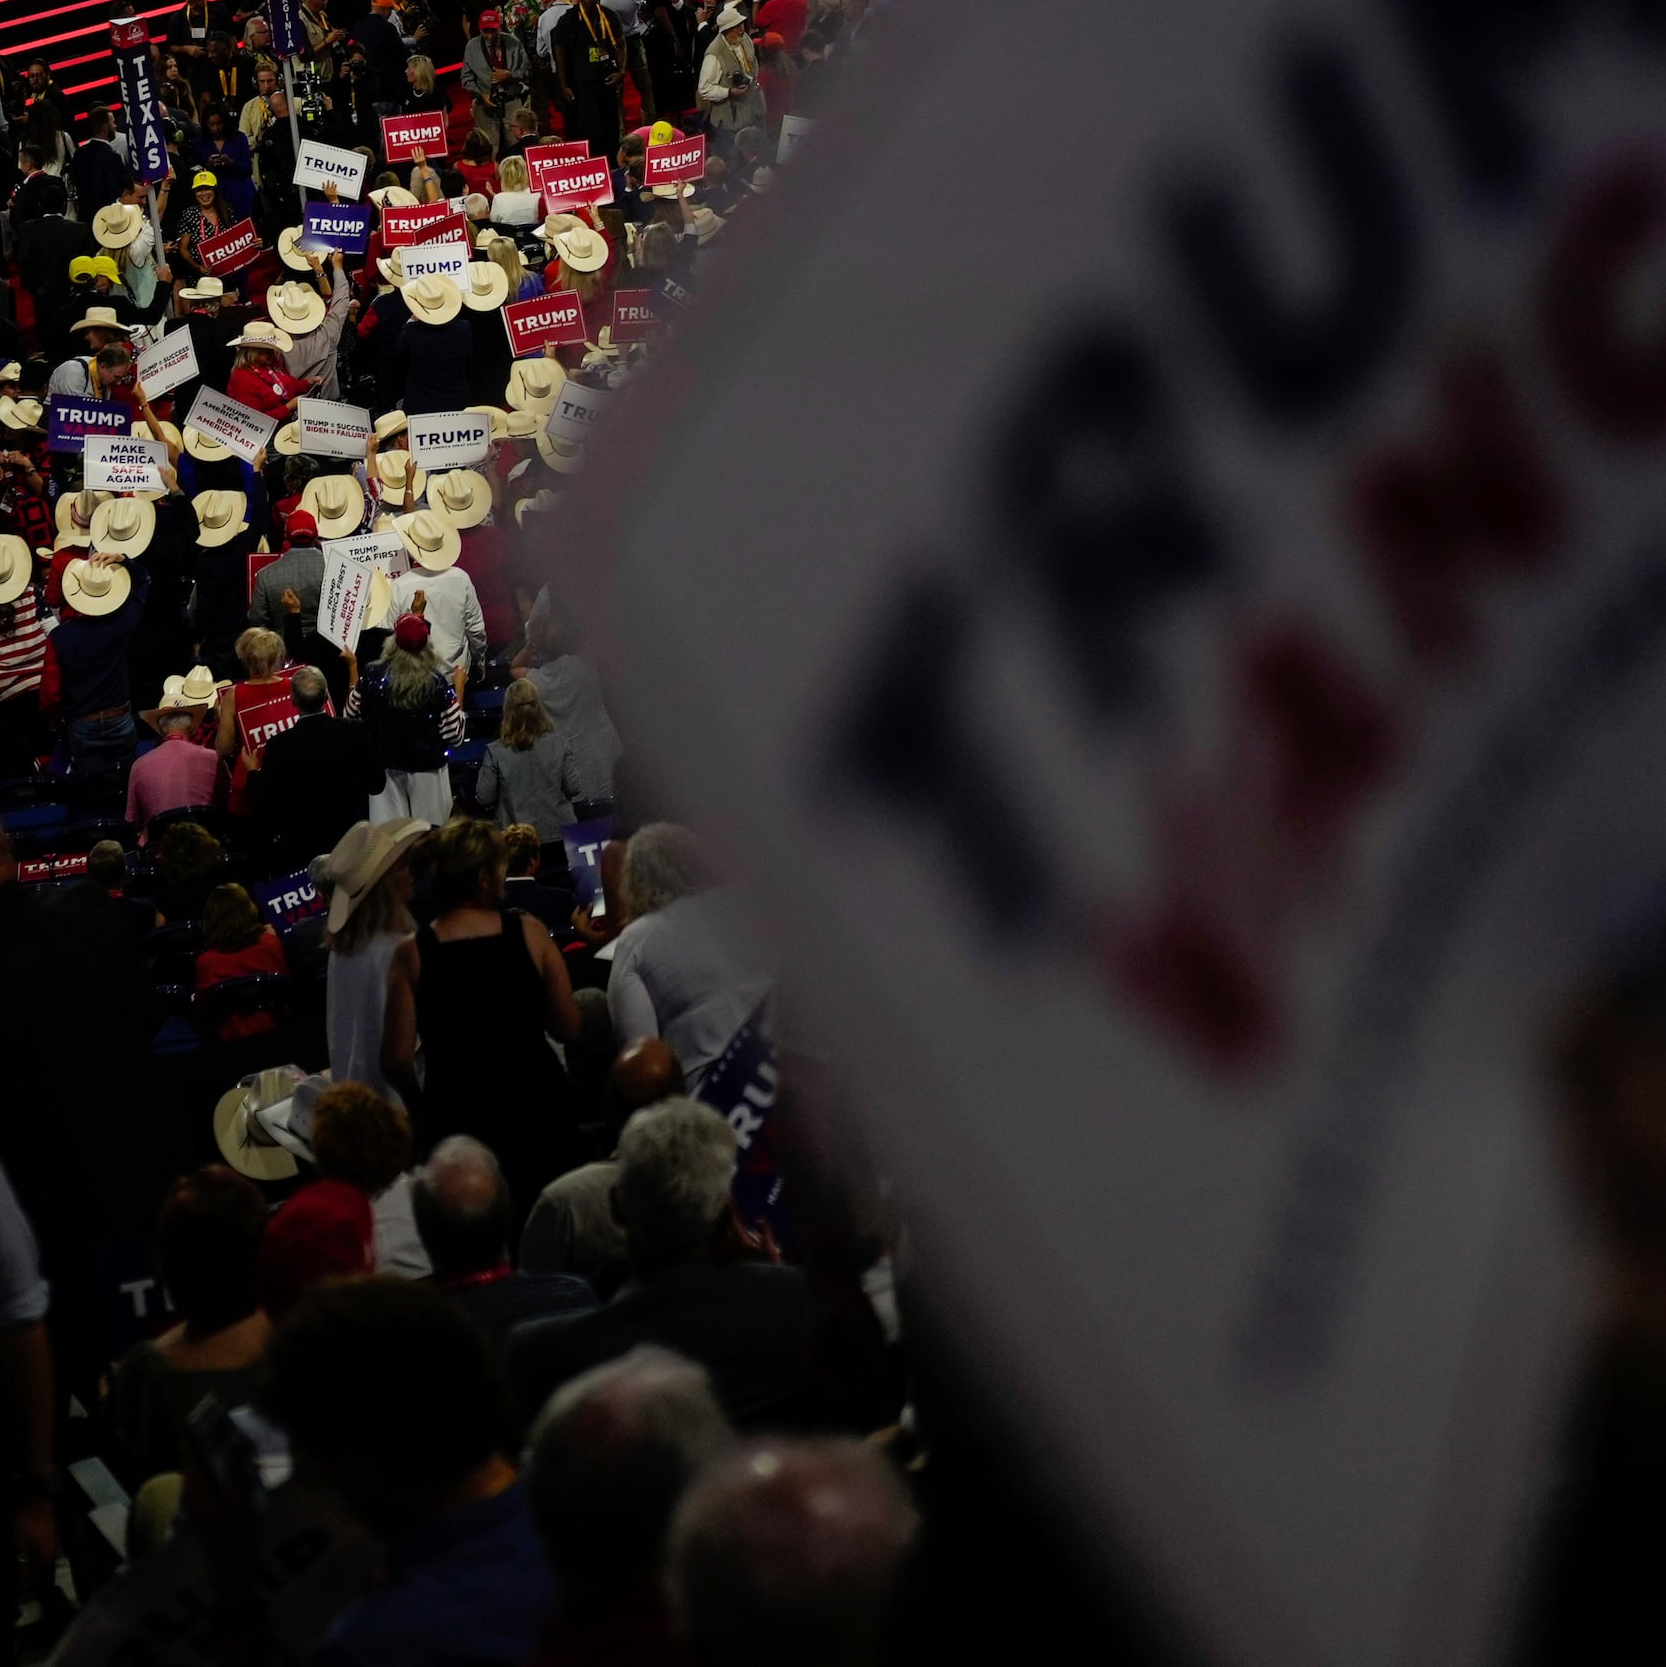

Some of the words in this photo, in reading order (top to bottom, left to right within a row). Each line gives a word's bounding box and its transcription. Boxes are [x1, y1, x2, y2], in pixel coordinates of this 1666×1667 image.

[116, 57, 139, 172] TEXAS
[132, 56, 161, 170] TEXAS
[388, 125, 442, 143] TRUMP
[304, 155, 359, 180] TRUMP
[649, 148, 702, 171] TRUMP
[547, 172, 606, 194] TRUMP
[309, 216, 365, 235] TRUMP
[205, 231, 255, 268] TRUMP
[407, 259, 463, 275] TRUMP
[512, 306, 579, 331] TRUMP
[163, 346, 190, 363] SUCCESS
[164, 352, 189, 369] FAILURE
[56, 408, 126, 427] TRUMP
[202, 401, 241, 423] AMERICA
[241, 418, 265, 434] FIRST
[221, 404, 251, 420] TRUMP
[196, 415, 235, 438] AMERICA
[235, 434, 256, 451] LAST
[216, 417, 242, 434] BIDEN
[303, 417, 330, 428] TRUMP
[336, 421, 369, 433] SUCCESS
[306, 426, 327, 434] BIDEN
[338, 430, 367, 441] FAILURE
[416, 429, 484, 447] TRUMP
[110, 444, 146, 454] MAKE
[100, 454, 156, 465] AMERICA
[106, 474, 149, 484] AGAIN!
[112, 465, 144, 475] SAFE
[348, 544, 379, 557] TRUMP
[352, 574, 363, 600] LAST
[340, 590, 351, 620] BIDEN
[249, 713, 300, 744] TRU
[268, 881, 316, 916] TRU
